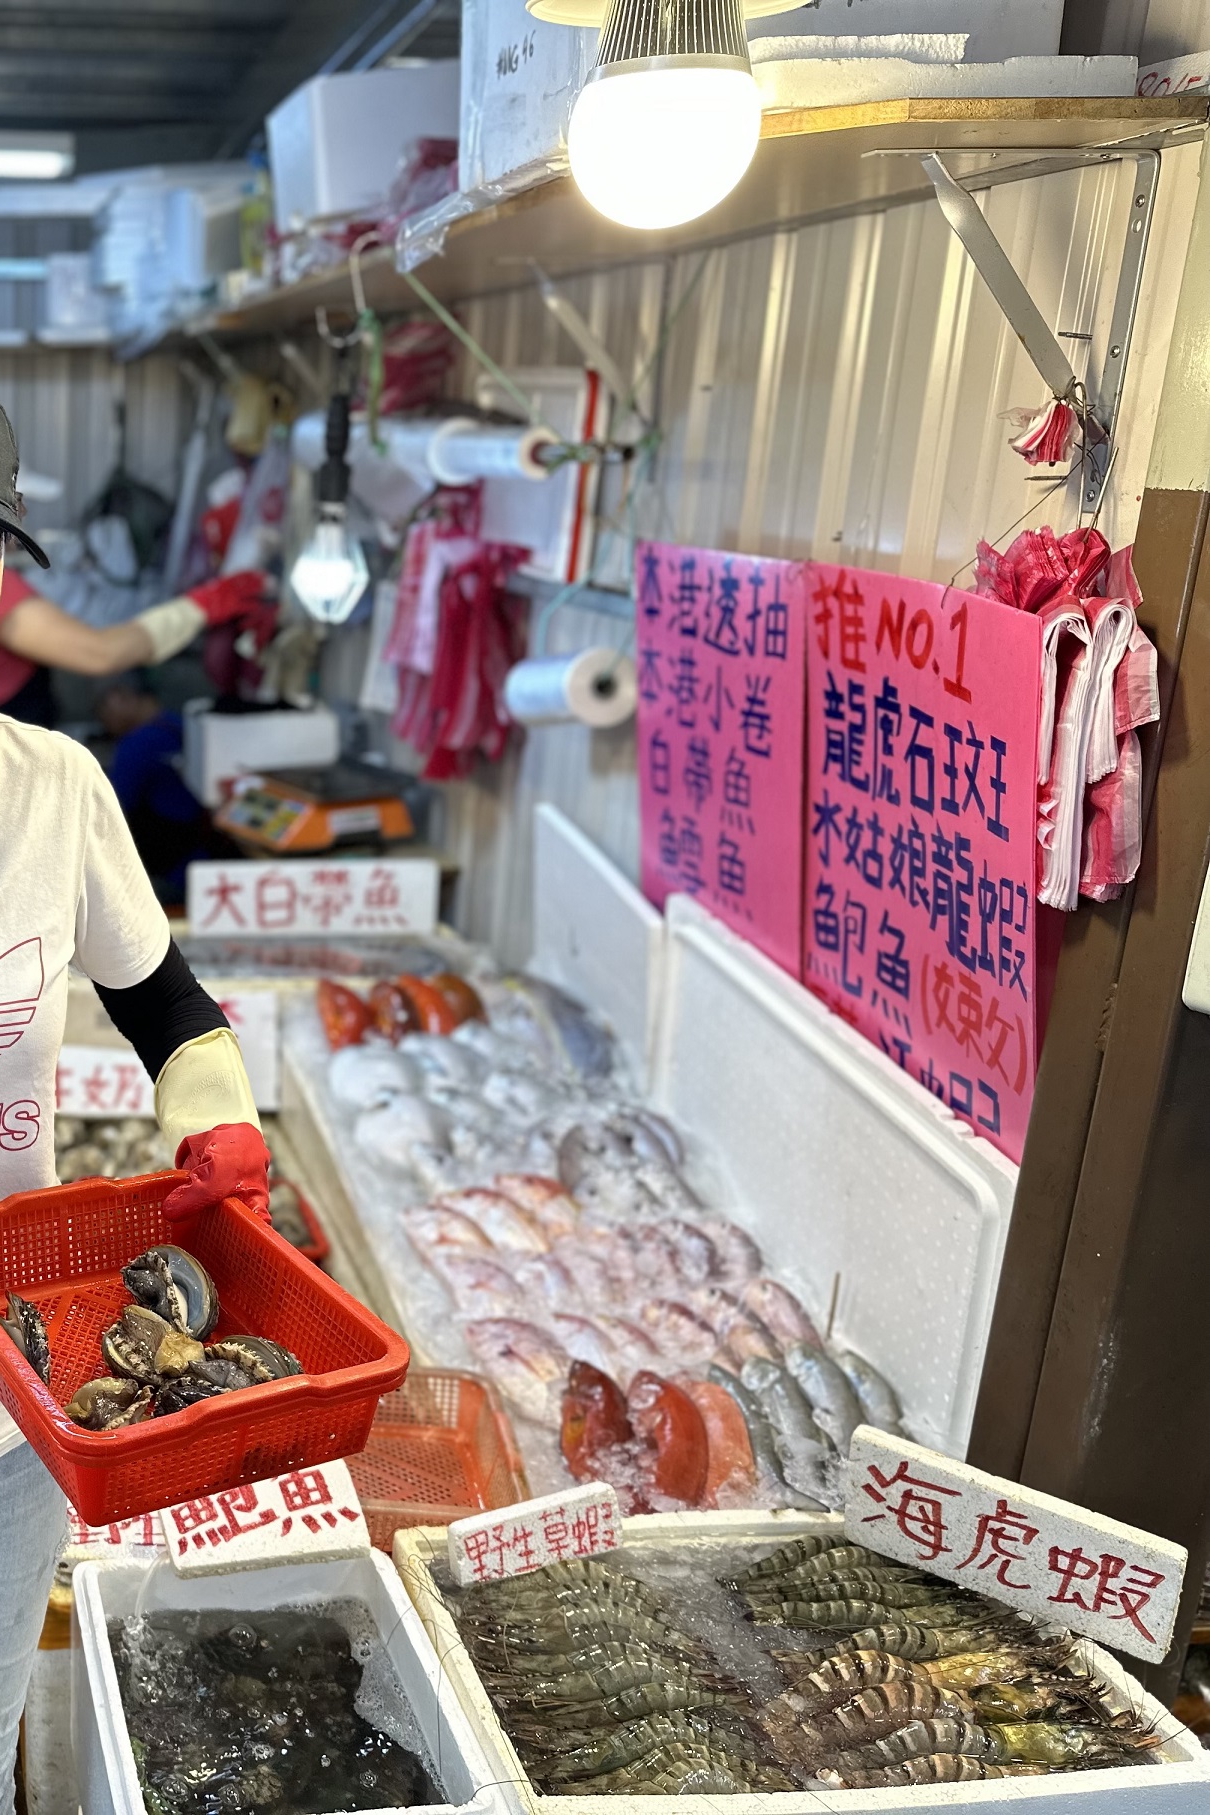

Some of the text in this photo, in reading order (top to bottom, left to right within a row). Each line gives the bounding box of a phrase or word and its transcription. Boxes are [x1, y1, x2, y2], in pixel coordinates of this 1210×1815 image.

[641, 547, 788, 660] 本港透抽
[640, 640, 772, 758] 本港小卷
[201, 865, 411, 931] 大白帶魚
[462, 1502, 618, 1583] 野生草蝦
[860, 1460, 1166, 1645] 海虎蝦
